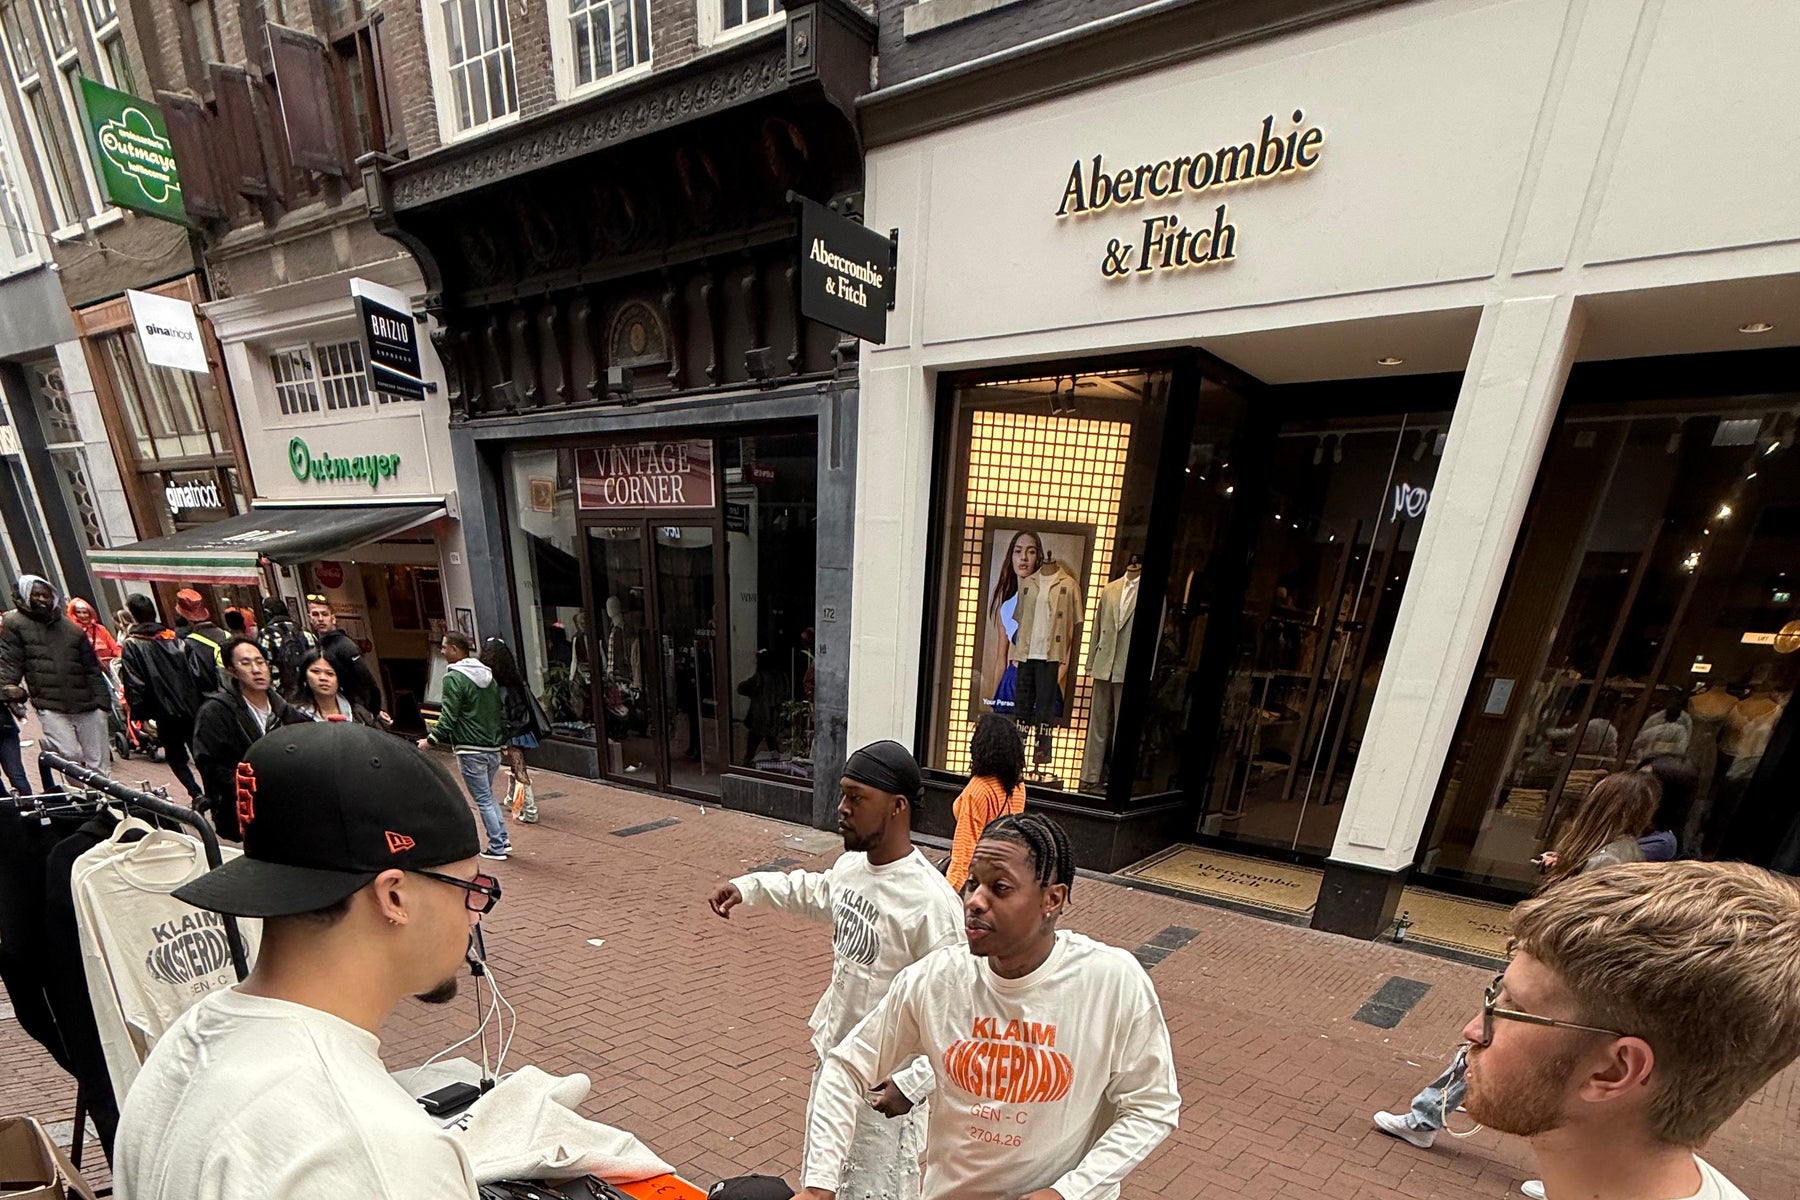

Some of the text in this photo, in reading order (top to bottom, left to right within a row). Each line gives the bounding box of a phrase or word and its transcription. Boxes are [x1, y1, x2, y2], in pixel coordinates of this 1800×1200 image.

[103, 132, 177, 172] Outmaye
[1055, 109, 1323, 216] Abercrombie
[1101, 204, 1236, 276] & Fitch
[809, 238, 883, 288] Abercrombie
[825, 275, 867, 307] & Fitch
[146, 323, 194, 341] ginatricot
[371, 314, 409, 343] BRIZIO
[288, 436, 401, 488] Outmayer
[595, 443, 691, 476] VINTAGE
[166, 479, 221, 514] ginatricot
[603, 475, 686, 505] CORNER
[823, 608, 835, 619] 172
[982, 698, 1015, 707] Your Perso
[840, 888, 880, 927] KLAIM
[152, 911, 224, 943] KLAIM
[146, 928, 249, 985] AMSTERDA
[972, 1017, 1057, 1048] KLAIM
[970, 1103, 1000, 1123] GEN
[1016, 1111, 1028, 1125] C
